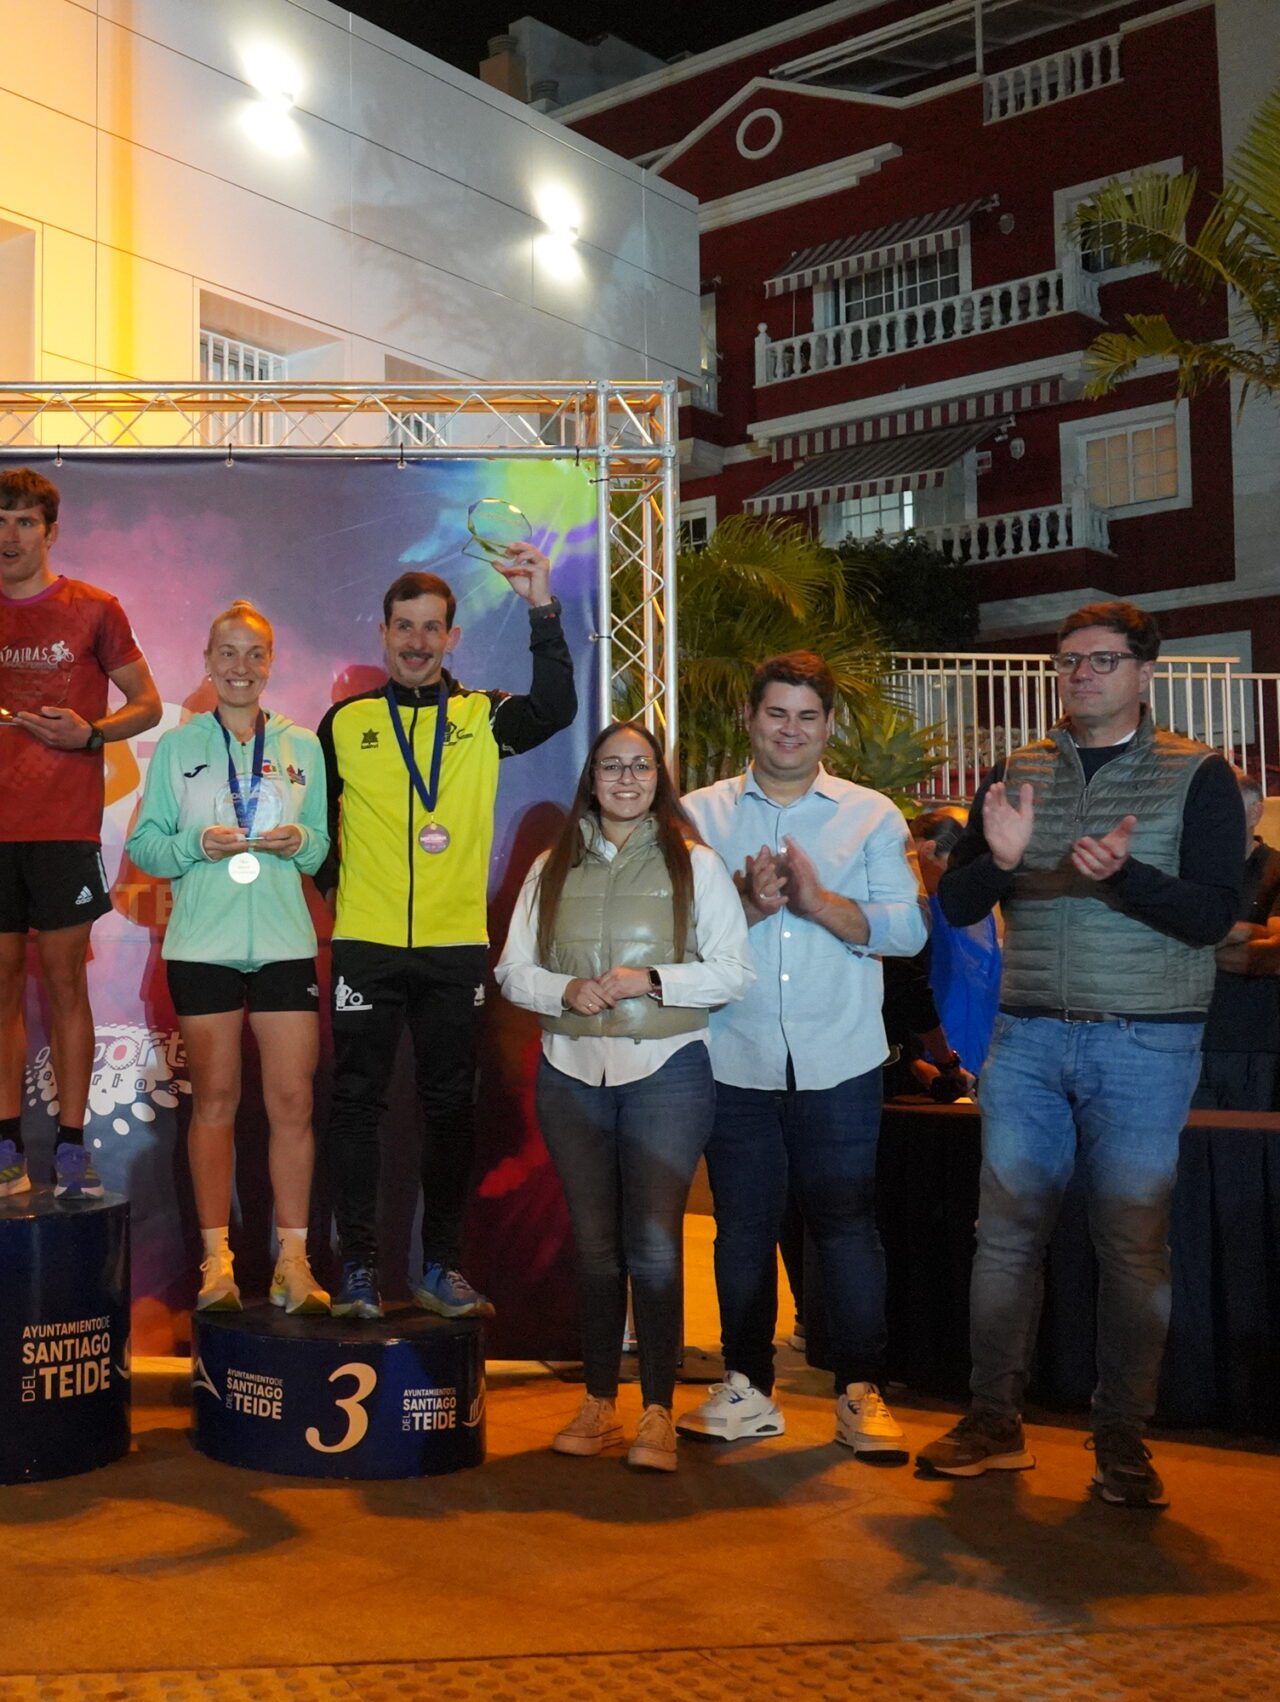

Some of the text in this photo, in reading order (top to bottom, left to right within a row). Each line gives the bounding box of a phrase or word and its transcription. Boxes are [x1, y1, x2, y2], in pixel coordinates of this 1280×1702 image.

[22, 1332, 111, 1365] SANTIAGO
[21, 1357, 111, 1402] DEL TEIDE
[226, 1377, 283, 1401] SANTIAGO
[233, 1392, 282, 1421] TEIDE
[305, 1362, 378, 1453] 3
[402, 1396, 457, 1412] SANTIAGO
[401, 1411, 457, 1431] DEL TEIDE
